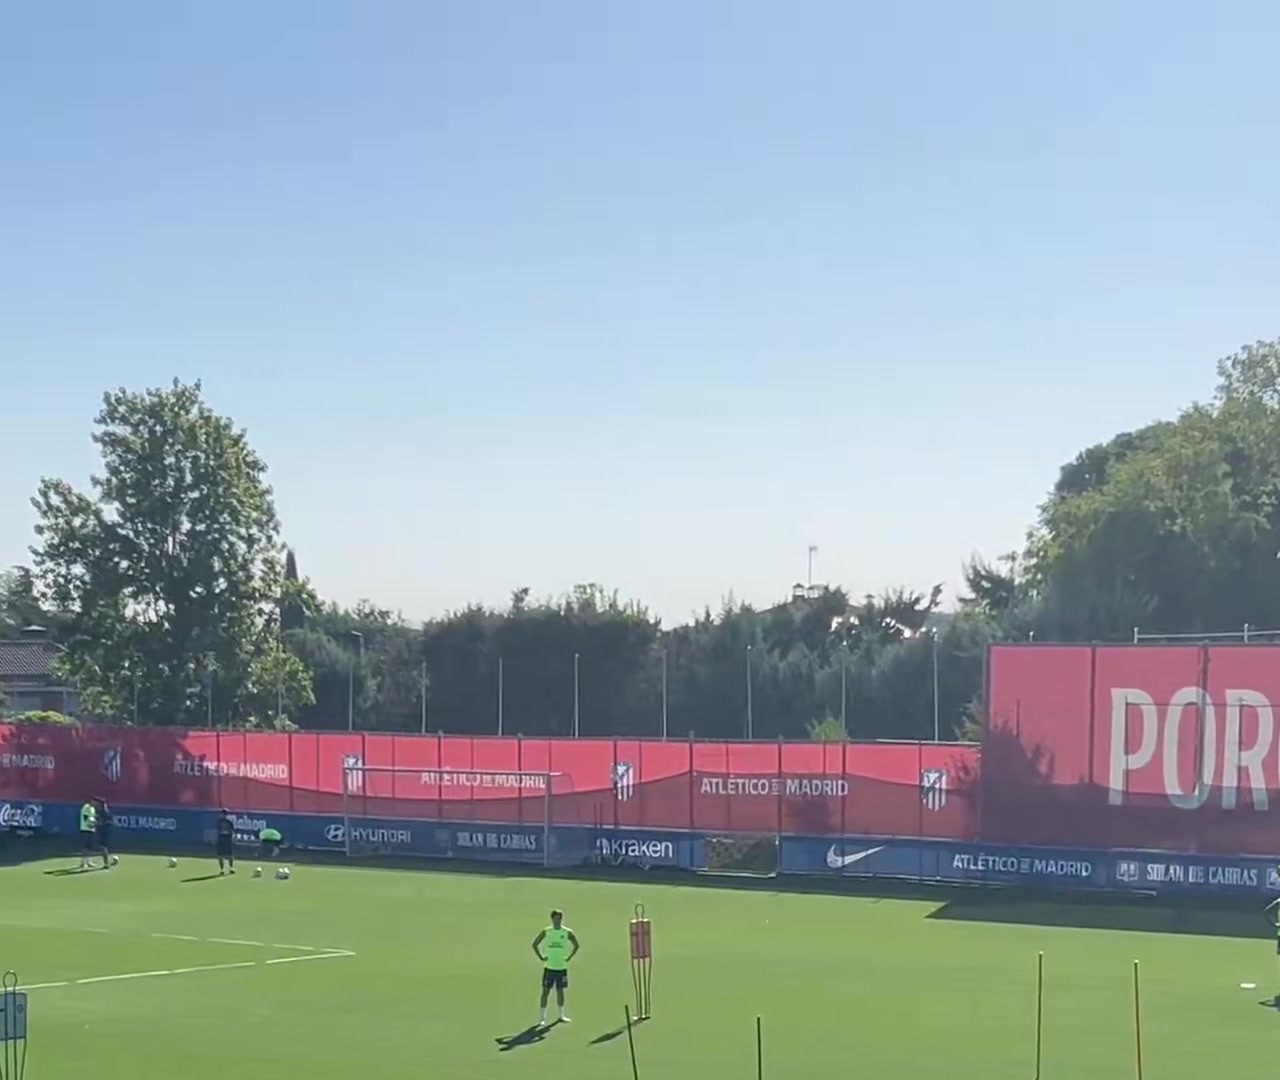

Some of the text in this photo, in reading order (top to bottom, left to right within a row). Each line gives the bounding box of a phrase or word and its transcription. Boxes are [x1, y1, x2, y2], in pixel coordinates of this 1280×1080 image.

[240, 762, 288, 779] MADRID
[700, 775, 769, 796] ATLÉTICO
[786, 778, 848, 797] MADRID
[952, 852, 1092, 877] ATLÉTICO MADRID
